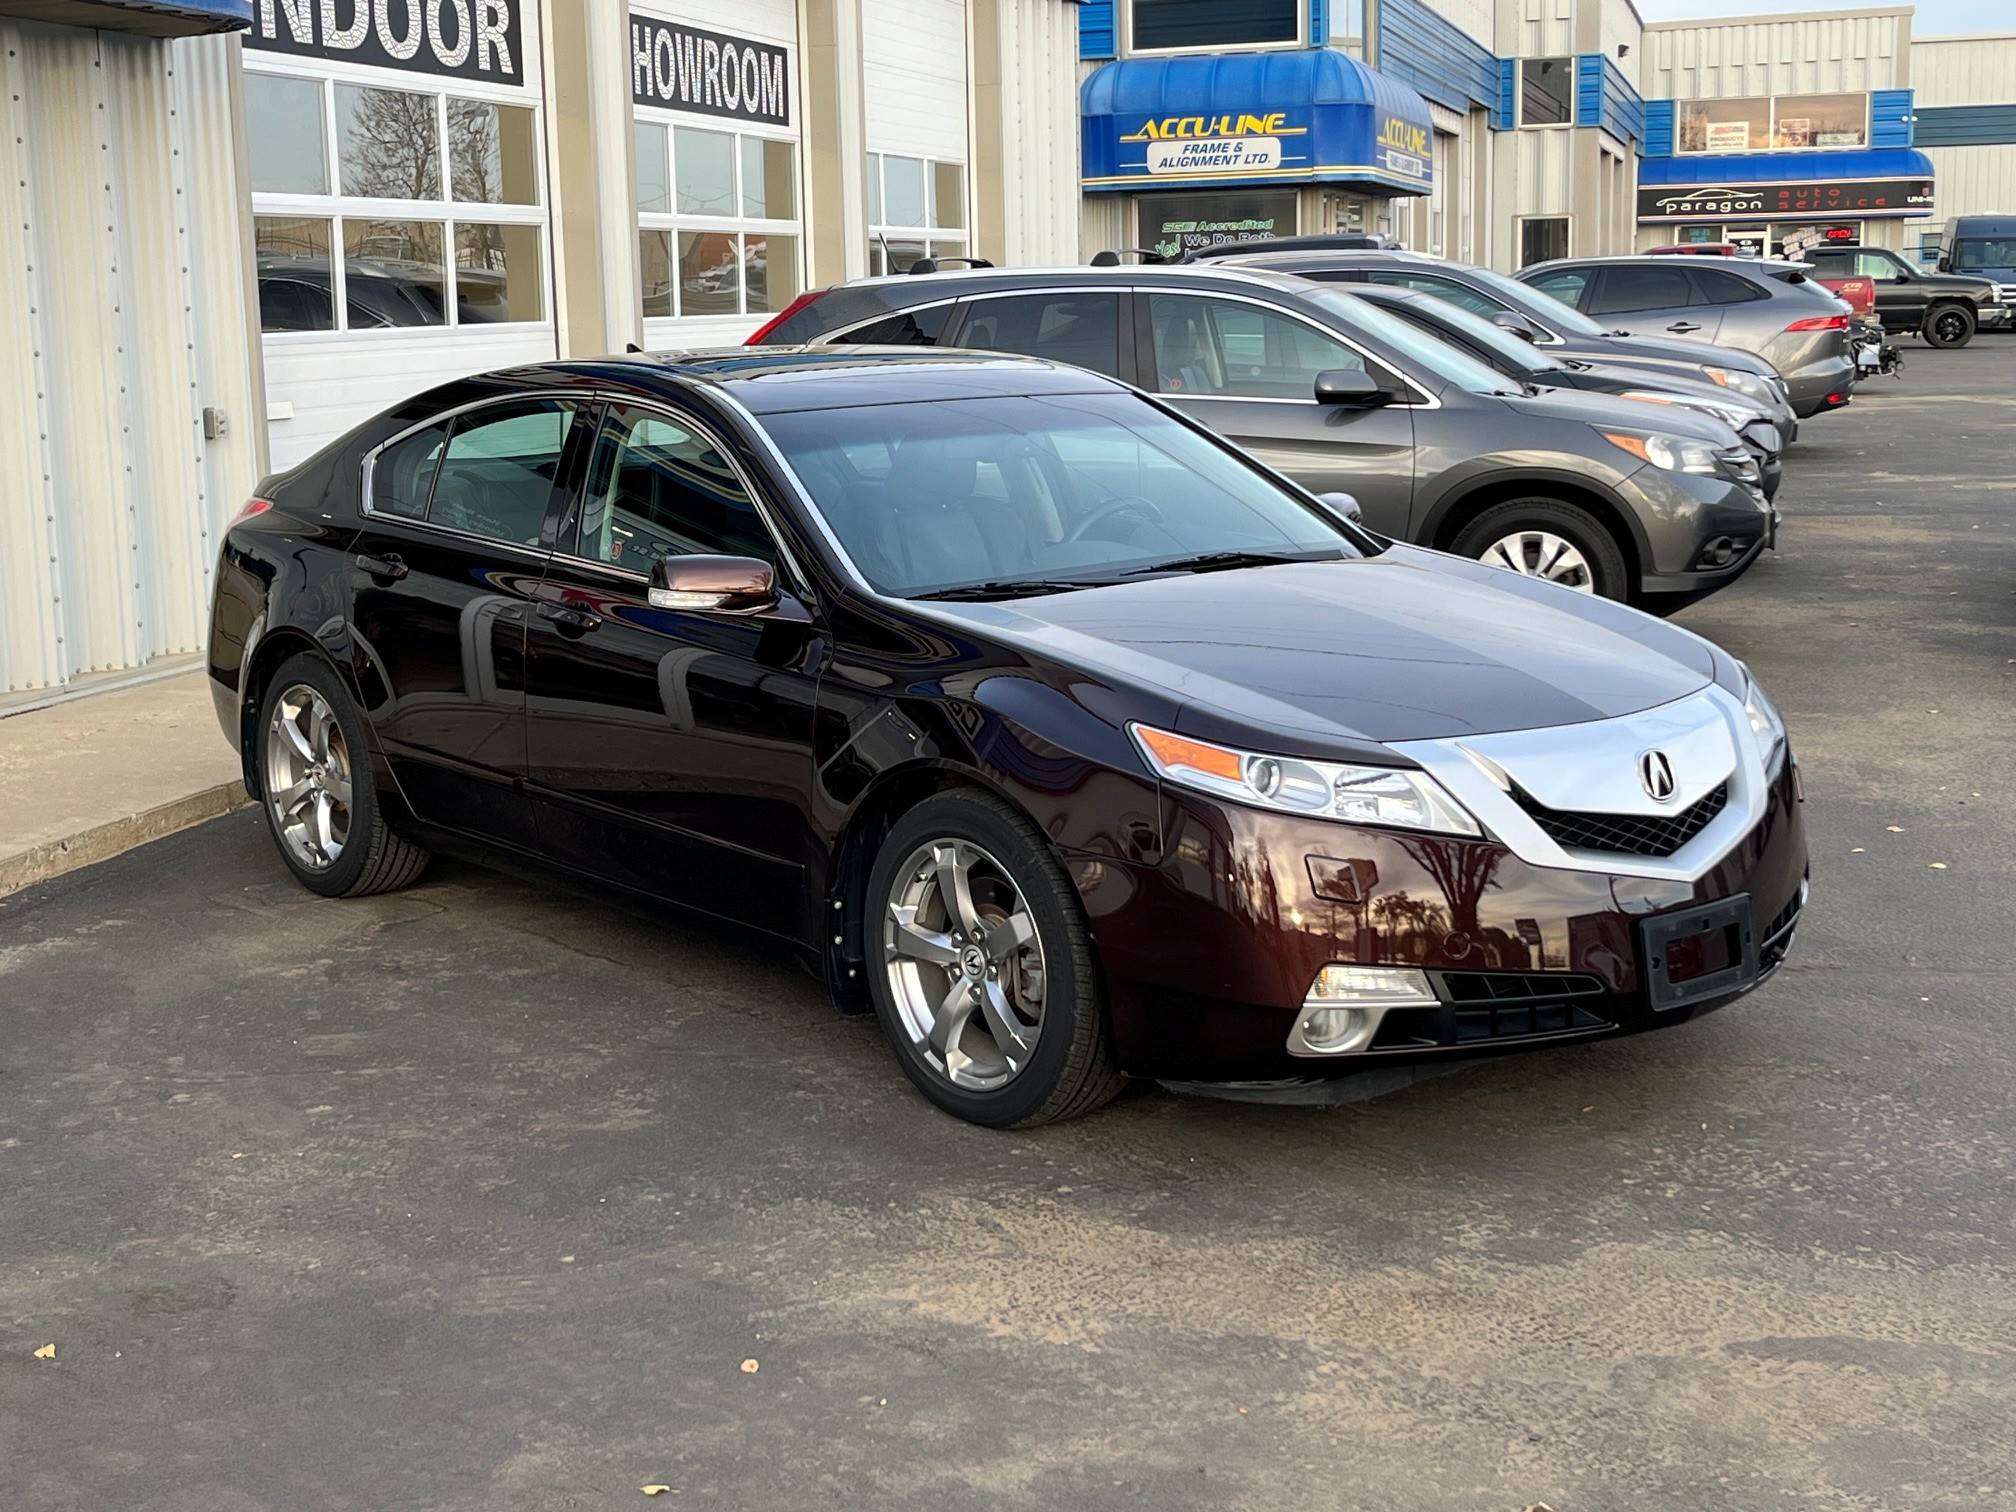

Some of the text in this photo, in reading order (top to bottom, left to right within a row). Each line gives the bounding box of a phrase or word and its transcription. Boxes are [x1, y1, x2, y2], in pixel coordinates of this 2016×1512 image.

[241, 0, 514, 74] NDOOR
[1121, 113, 1307, 142] ACCU-LINE
[1182, 142, 1243, 154] FRAME &
[1159, 153, 1271, 168] ALIGNMENT LTD.
[1778, 187, 1841, 198] auto
[1665, 200, 1762, 214] paragon
[1778, 197, 1887, 209] service
[1197, 219, 1274, 231] Accredited
[1155, 234, 1181, 258] Yes!
[1184, 233, 1210, 247] We
[1212, 233, 1236, 246] Do
